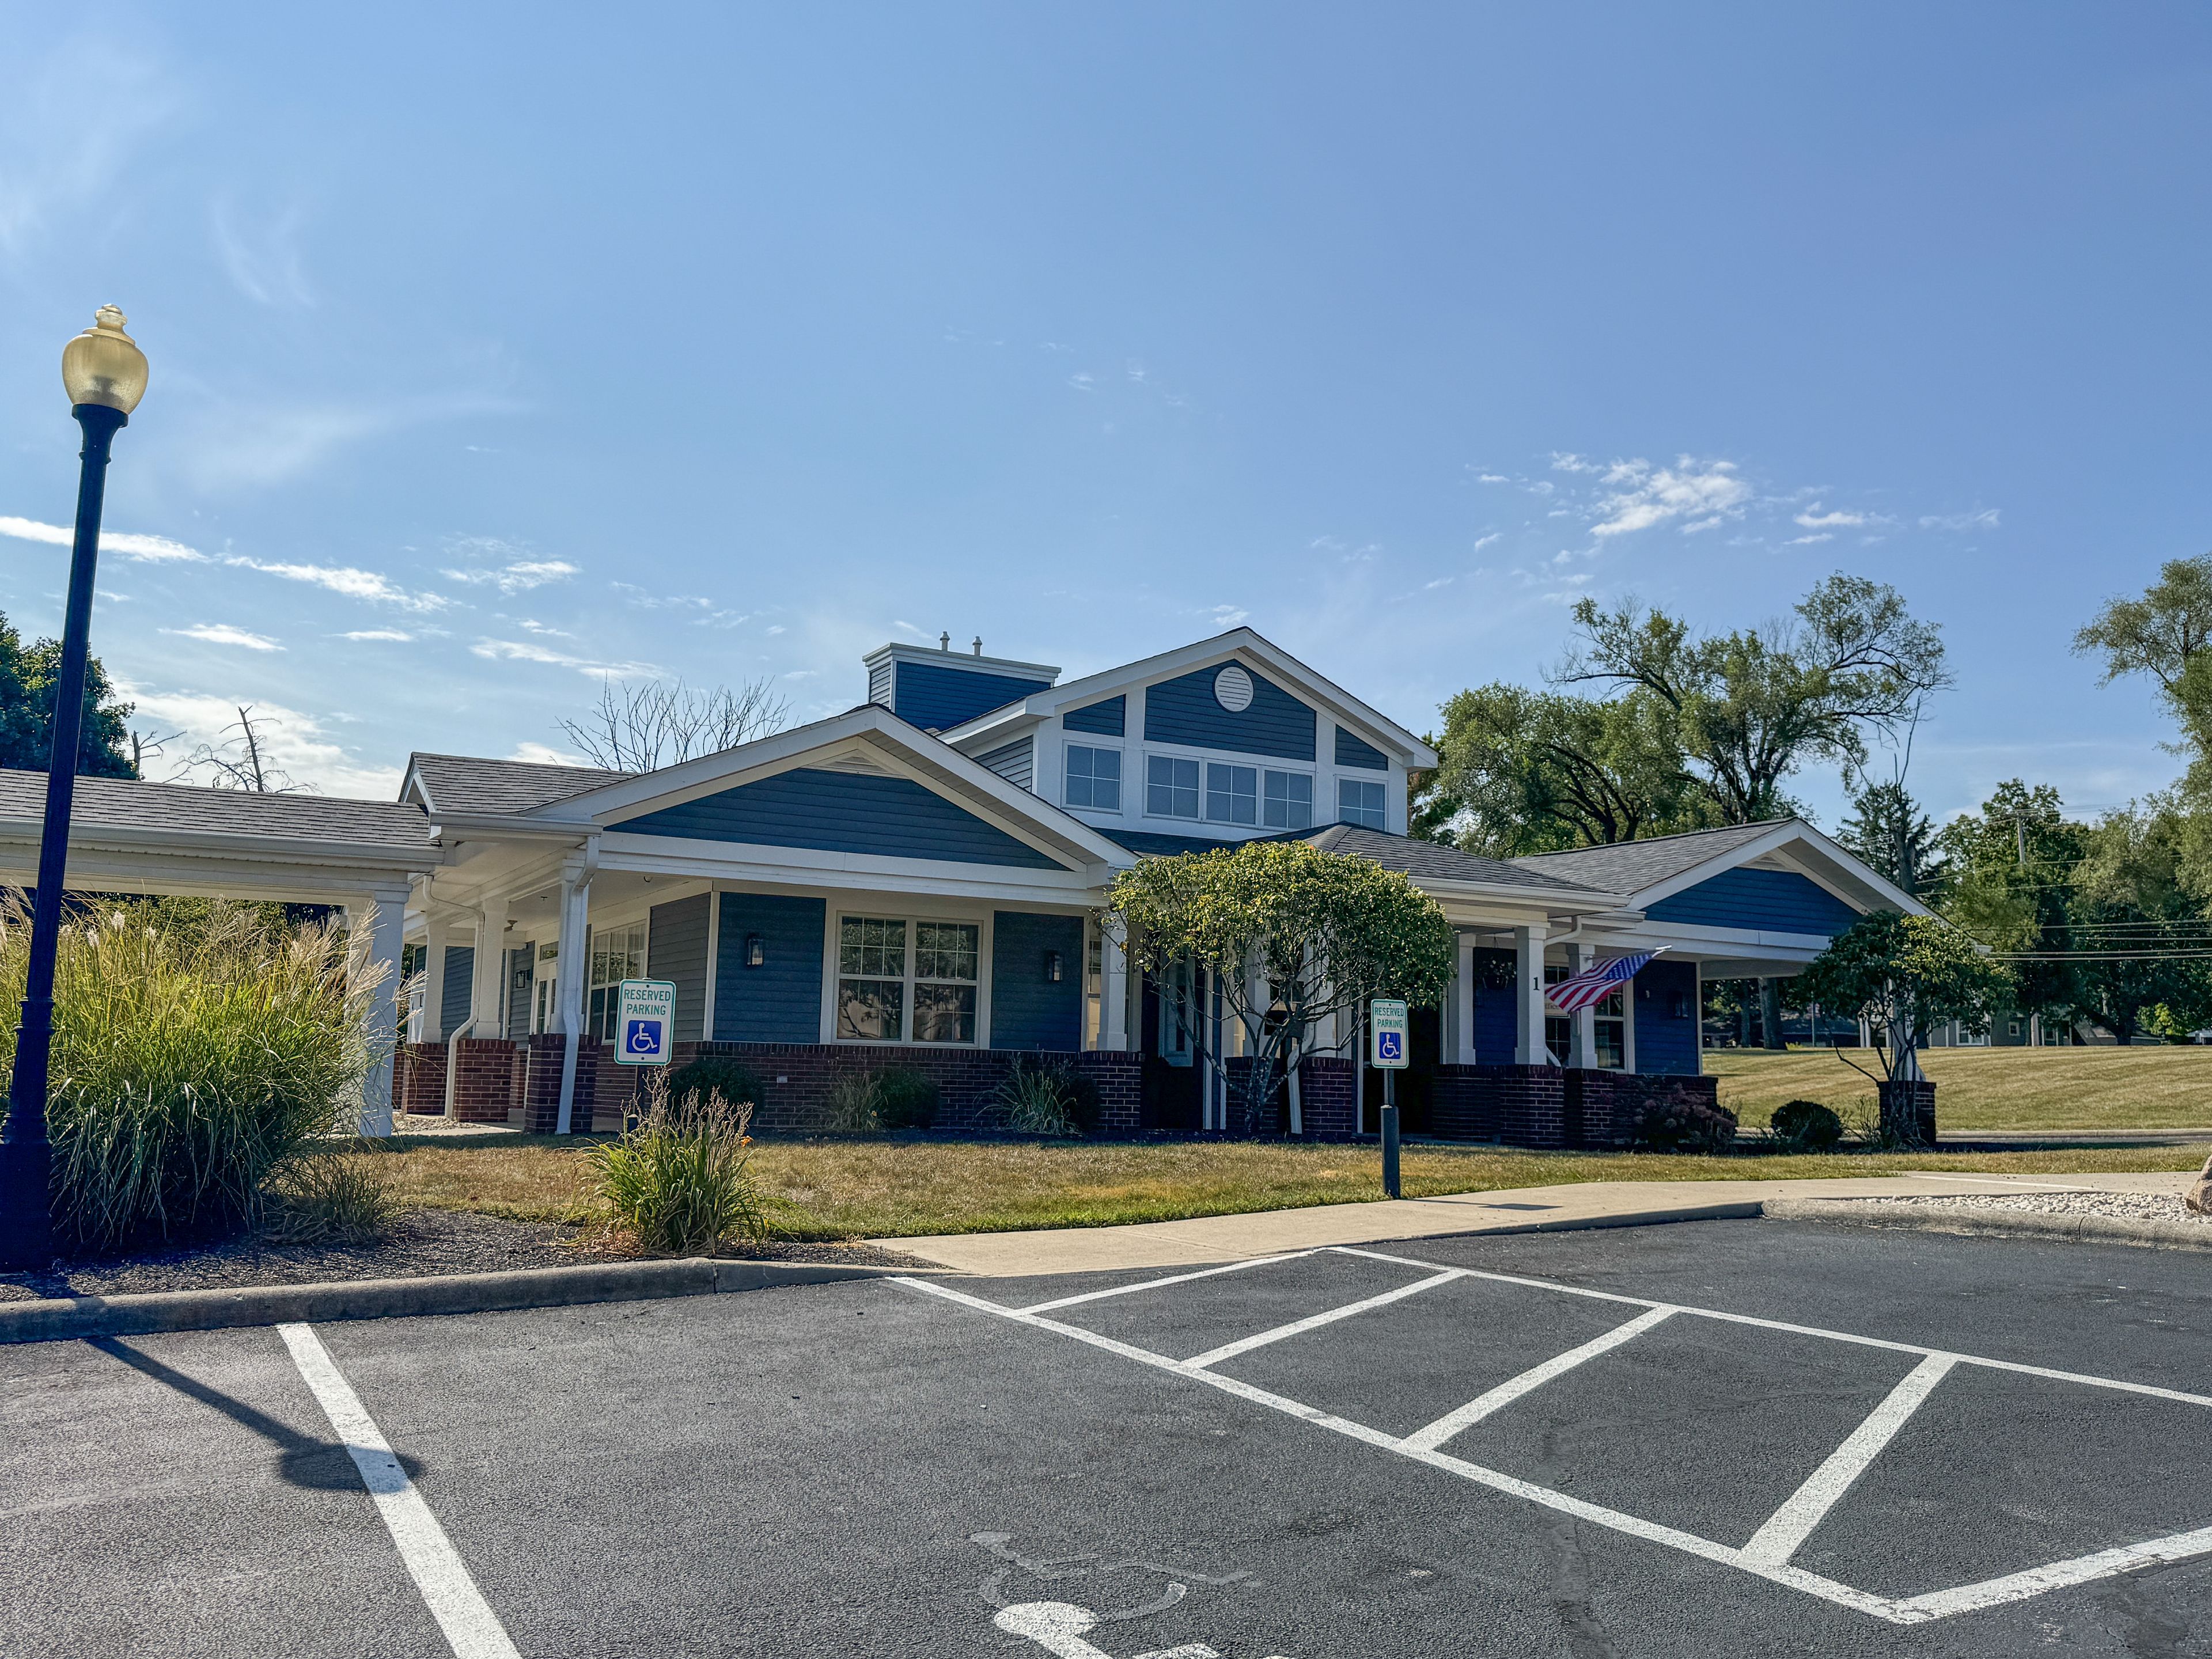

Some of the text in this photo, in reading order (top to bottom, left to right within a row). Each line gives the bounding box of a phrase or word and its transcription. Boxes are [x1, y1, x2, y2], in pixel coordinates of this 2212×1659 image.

[1533, 976, 1540, 990] 1
[624, 989, 671, 1001] RESERVED
[627, 1004, 666, 1015] PARKING
[1375, 1007, 1404, 1016] RESERVED
[1377, 1019, 1403, 1028] PARKING
